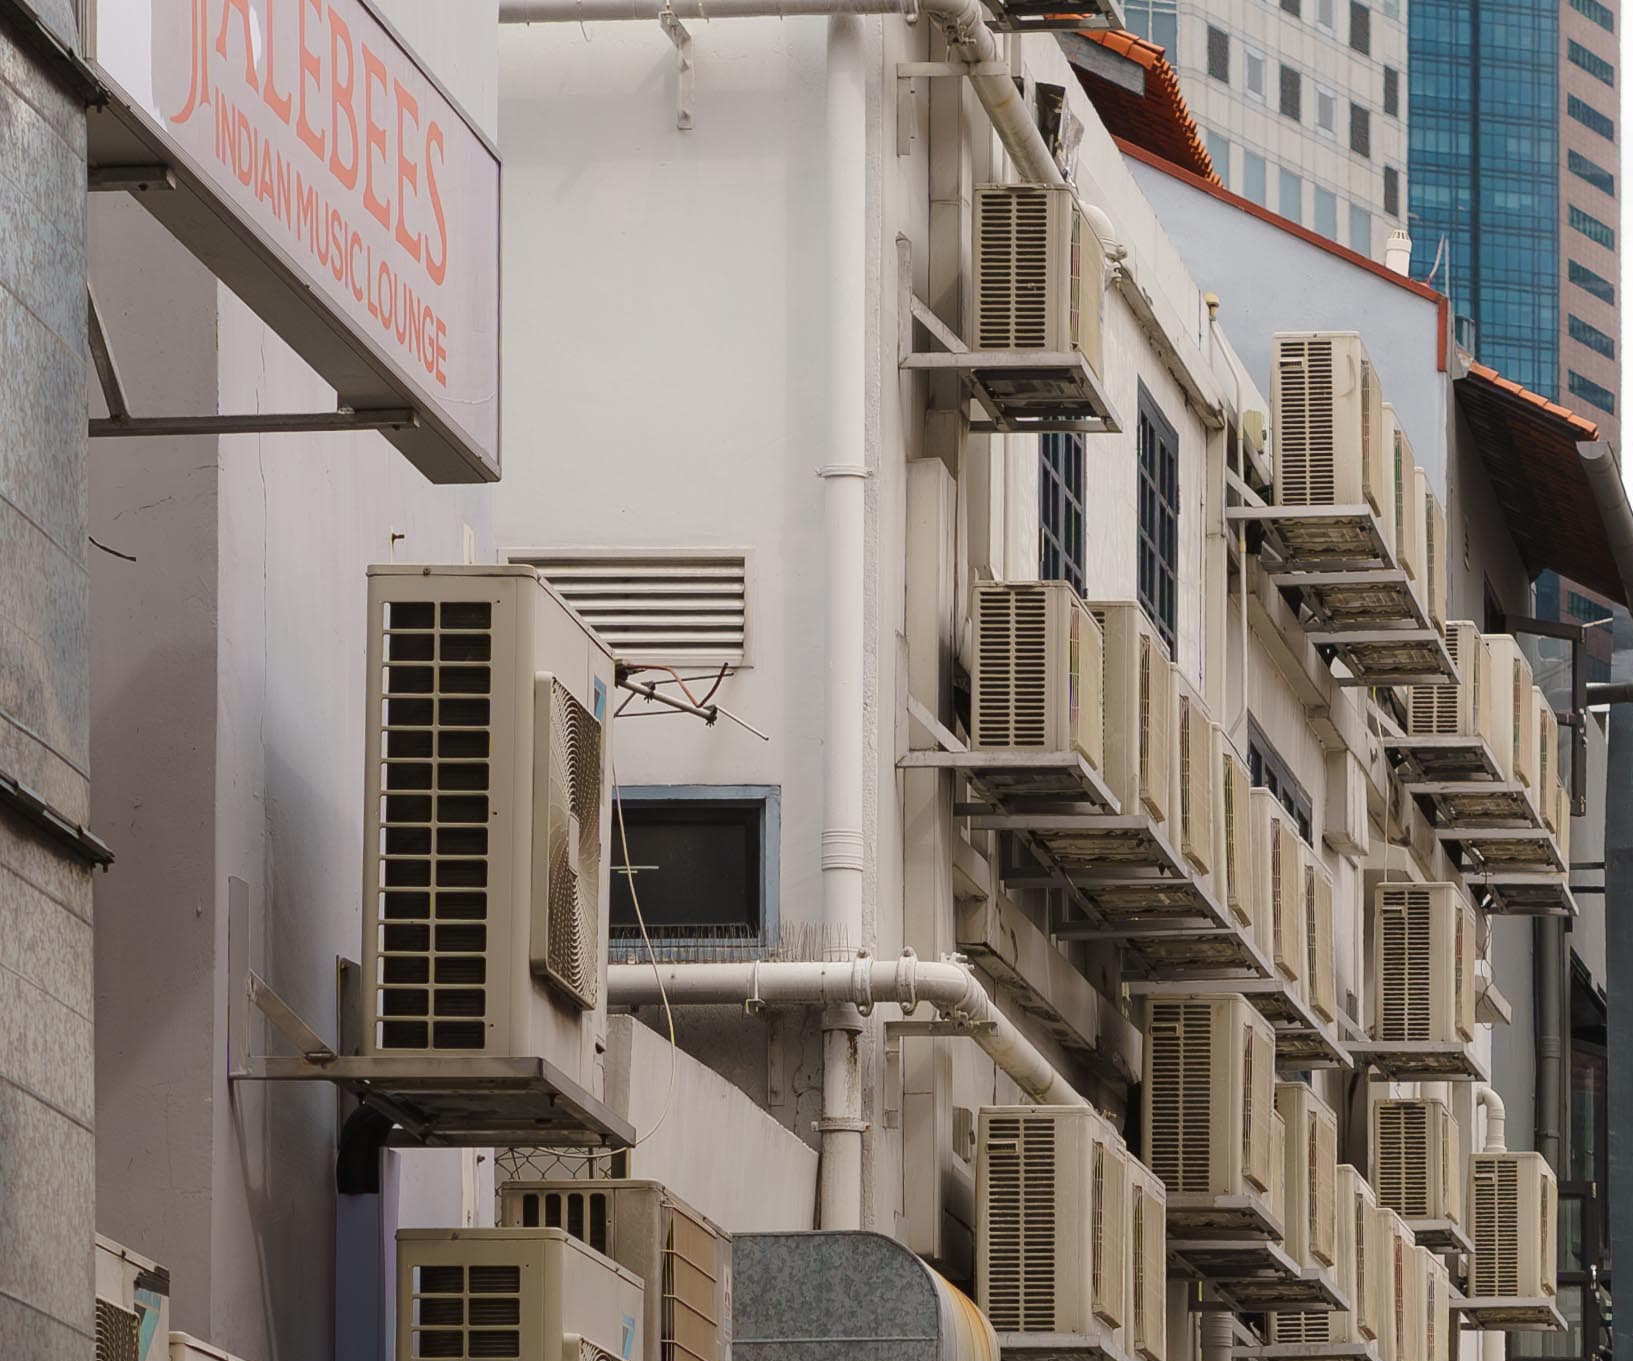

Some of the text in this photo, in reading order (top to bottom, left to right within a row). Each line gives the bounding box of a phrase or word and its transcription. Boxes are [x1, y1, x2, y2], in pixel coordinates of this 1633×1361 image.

[216, 86, 447, 388] INDIAN MUSIC LOUNGE
